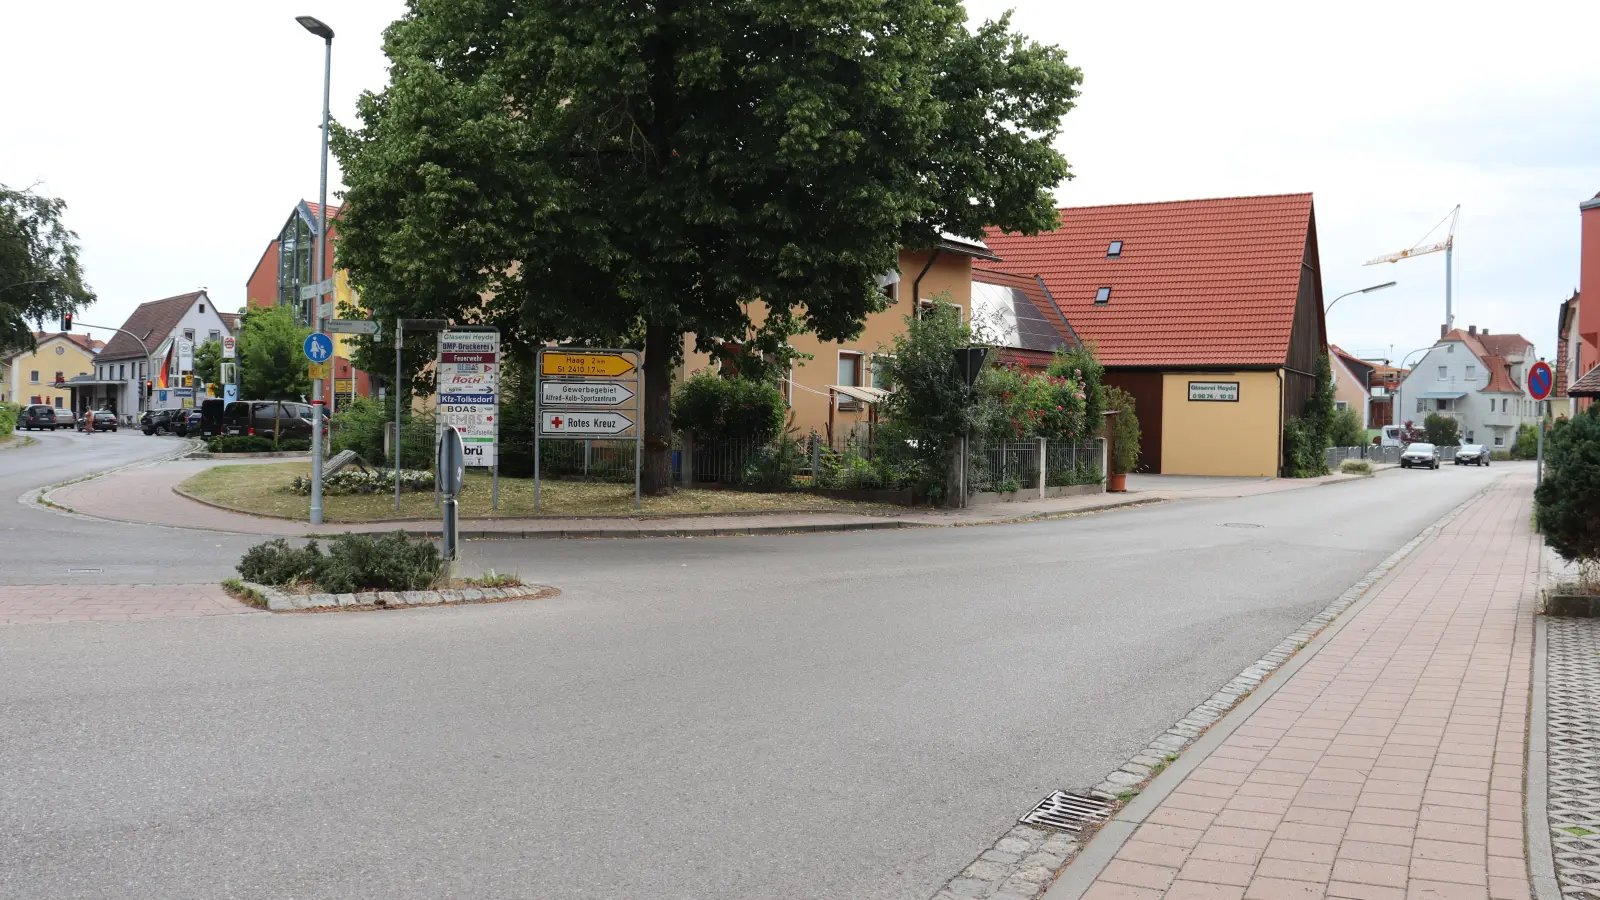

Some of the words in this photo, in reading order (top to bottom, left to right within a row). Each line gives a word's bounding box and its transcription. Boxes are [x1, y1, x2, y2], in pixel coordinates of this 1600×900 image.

[566, 357, 584, 365] Haag
[562, 386, 616, 394] Gewerbegebiet
[568, 418, 590, 428] Rotes
[594, 418, 616, 428] Kreuz
